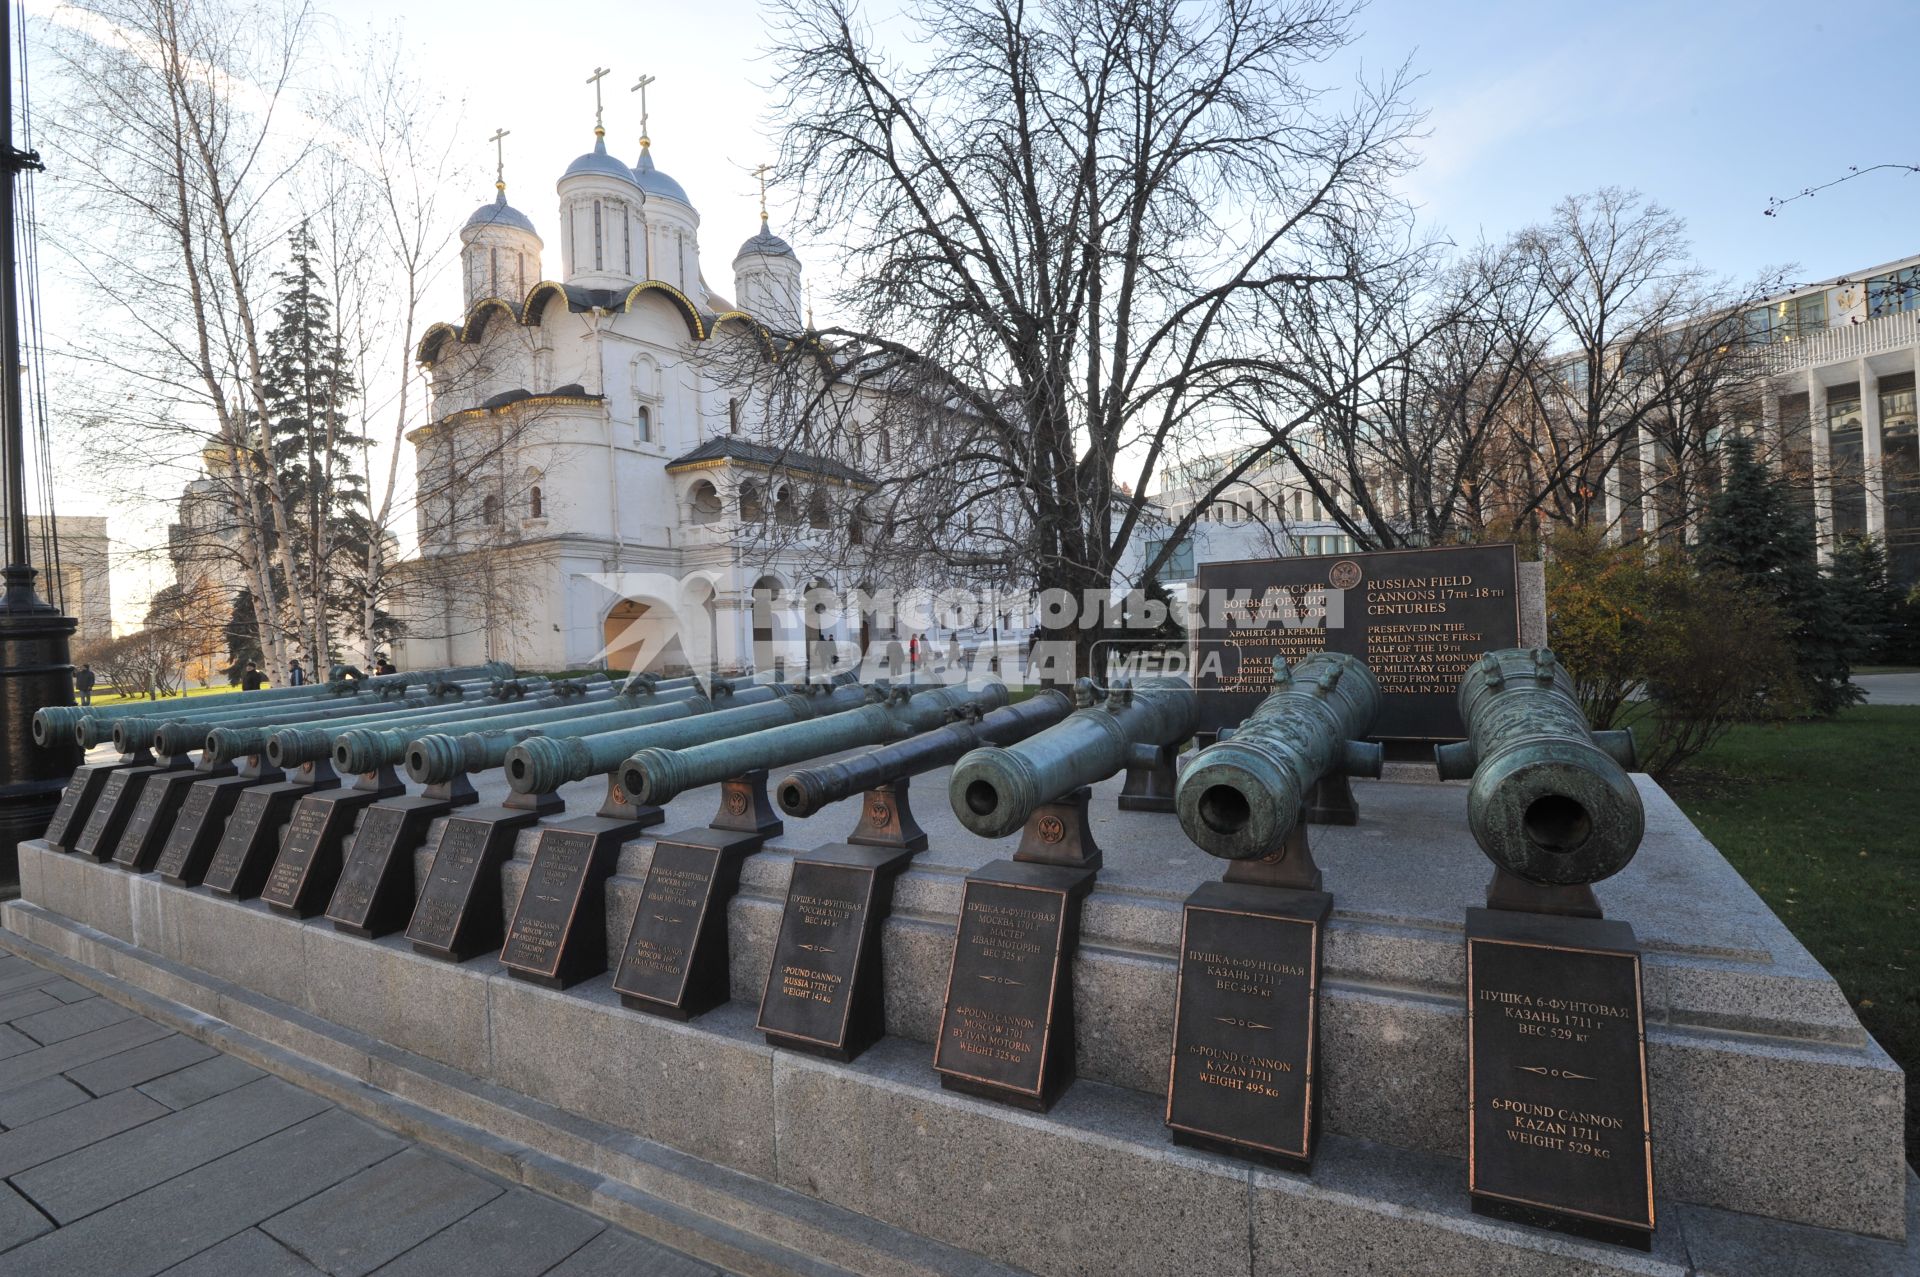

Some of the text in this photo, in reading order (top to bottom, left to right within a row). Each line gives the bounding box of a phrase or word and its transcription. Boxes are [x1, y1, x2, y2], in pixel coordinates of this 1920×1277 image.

[1267, 583, 1325, 595] РУССКИЕ
[1367, 576, 1472, 590] RUSSIAN FIELD
[1223, 595, 1325, 609] БОЕВЫЕ ОРУДИЯ
[1367, 590, 1436, 602] CANNONS
[1284, 607, 1326, 618] ВЕКОВ
[1367, 602, 1446, 615] CENTURIES
[1229, 627, 1326, 638] ХРАНЯТСЯ В КРЕМЛЕ
[1368, 623, 1465, 634] PRESERVED IN THE
[1232, 638, 1269, 647] ПЕРВОЙ
[1271, 637, 1326, 646] ПОЛОВИНЫ
[1368, 632, 1483, 644] KREMLIN SINCE FIRST
[1368, 645, 1396, 654] HALF
[1398, 644, 1412, 653] OF
[1414, 644, 1434, 652] THE
[1243, 657, 1262, 665] КАК
[1368, 654, 1417, 664] CENTURY
[1419, 654, 1432, 662] AS
[1384, 664, 1435, 672] MILITARY
[1377, 674, 1463, 683] OVED FROM THE
[1434, 685, 1456, 693] 2012
[790, 894, 816, 905] ПУШКА
[798, 905, 827, 916] РОССИЯ
[968, 902, 1056, 922] ПУШКА 4-ФУНТОВАЯ
[804, 915, 818, 924] ВЕС
[978, 914, 1014, 928] МОСКВА
[990, 928, 1025, 940] МАСТЕР
[972, 935, 1040, 954] ИВАН МОТОРИН
[983, 948, 1000, 958] ВЕС
[1002, 951, 1015, 960] 325
[1189, 950, 1304, 976] ПУШКА 6-ФУНТОВАЯ
[780, 965, 842, 984] 1-POUND CANNON
[1207, 966, 1250, 981] КАЗАНЬ
[1254, 973, 1274, 985] 1711
[784, 976, 834, 993] RUSSIA 17TH C
[1216, 980, 1272, 997] ВЕС 495 кг
[784, 986, 810, 998] WEIGHT
[812, 992, 822, 1000] 143
[1480, 990, 1630, 1018] ПУШКА 6-ФУНТОВАЯ
[956, 1006, 1034, 1029] 4-POUND CANNON
[1505, 1007, 1560, 1024] КАЗАНЬ
[1565, 1015, 1592, 1028] 1711
[964, 1018, 1024, 1039] MOSCOW 1701
[1518, 1024, 1589, 1042] ВЕС 529 кг
[953, 1028, 1032, 1053] BY IVAN MOTORIN
[960, 1041, 993, 1057] WEIGHT
[994, 1049, 1010, 1060] 325
[1190, 1044, 1291, 1072] 6-POUND CANNON
[1206, 1060, 1272, 1082] KAZAN 1711
[1200, 1072, 1279, 1098] WEIGHT 495 KG
[1492, 1098, 1623, 1129] 6-POUND CANNON
[1515, 1116, 1600, 1141] KAZAN 1711
[1506, 1130, 1610, 1159] WEIGHT 529 KG
